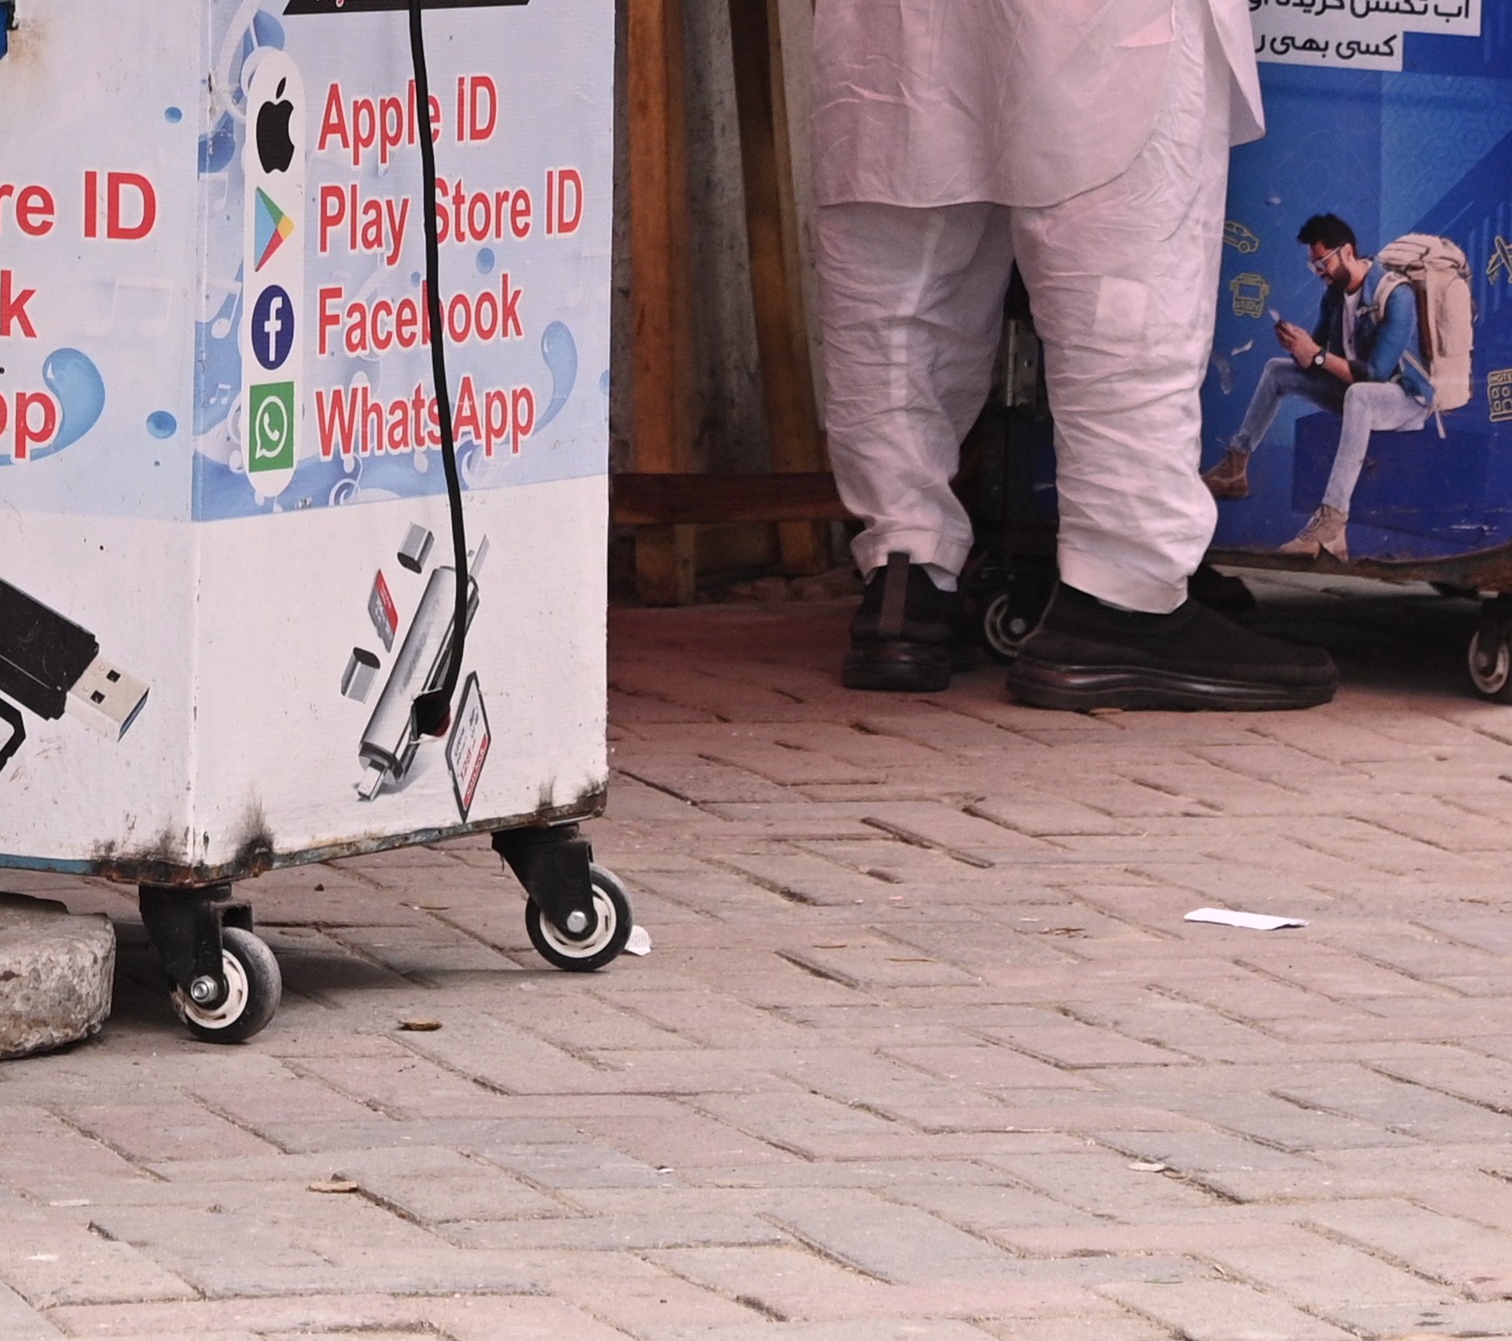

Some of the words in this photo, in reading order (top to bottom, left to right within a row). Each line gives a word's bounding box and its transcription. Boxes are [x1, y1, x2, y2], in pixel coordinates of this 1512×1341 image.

[1269, 35, 1330, 59] بھی
[1334, 34, 1398, 61] کسی
[456, 75, 498, 142] ID
[83, 170, 158, 240] ID
[318, 183, 410, 267] Play
[435, 175, 532, 244] Store
[544, 168, 584, 236] ID
[317, 272, 525, 356] Facebook
[314, 376, 536, 458] WhatsApp
